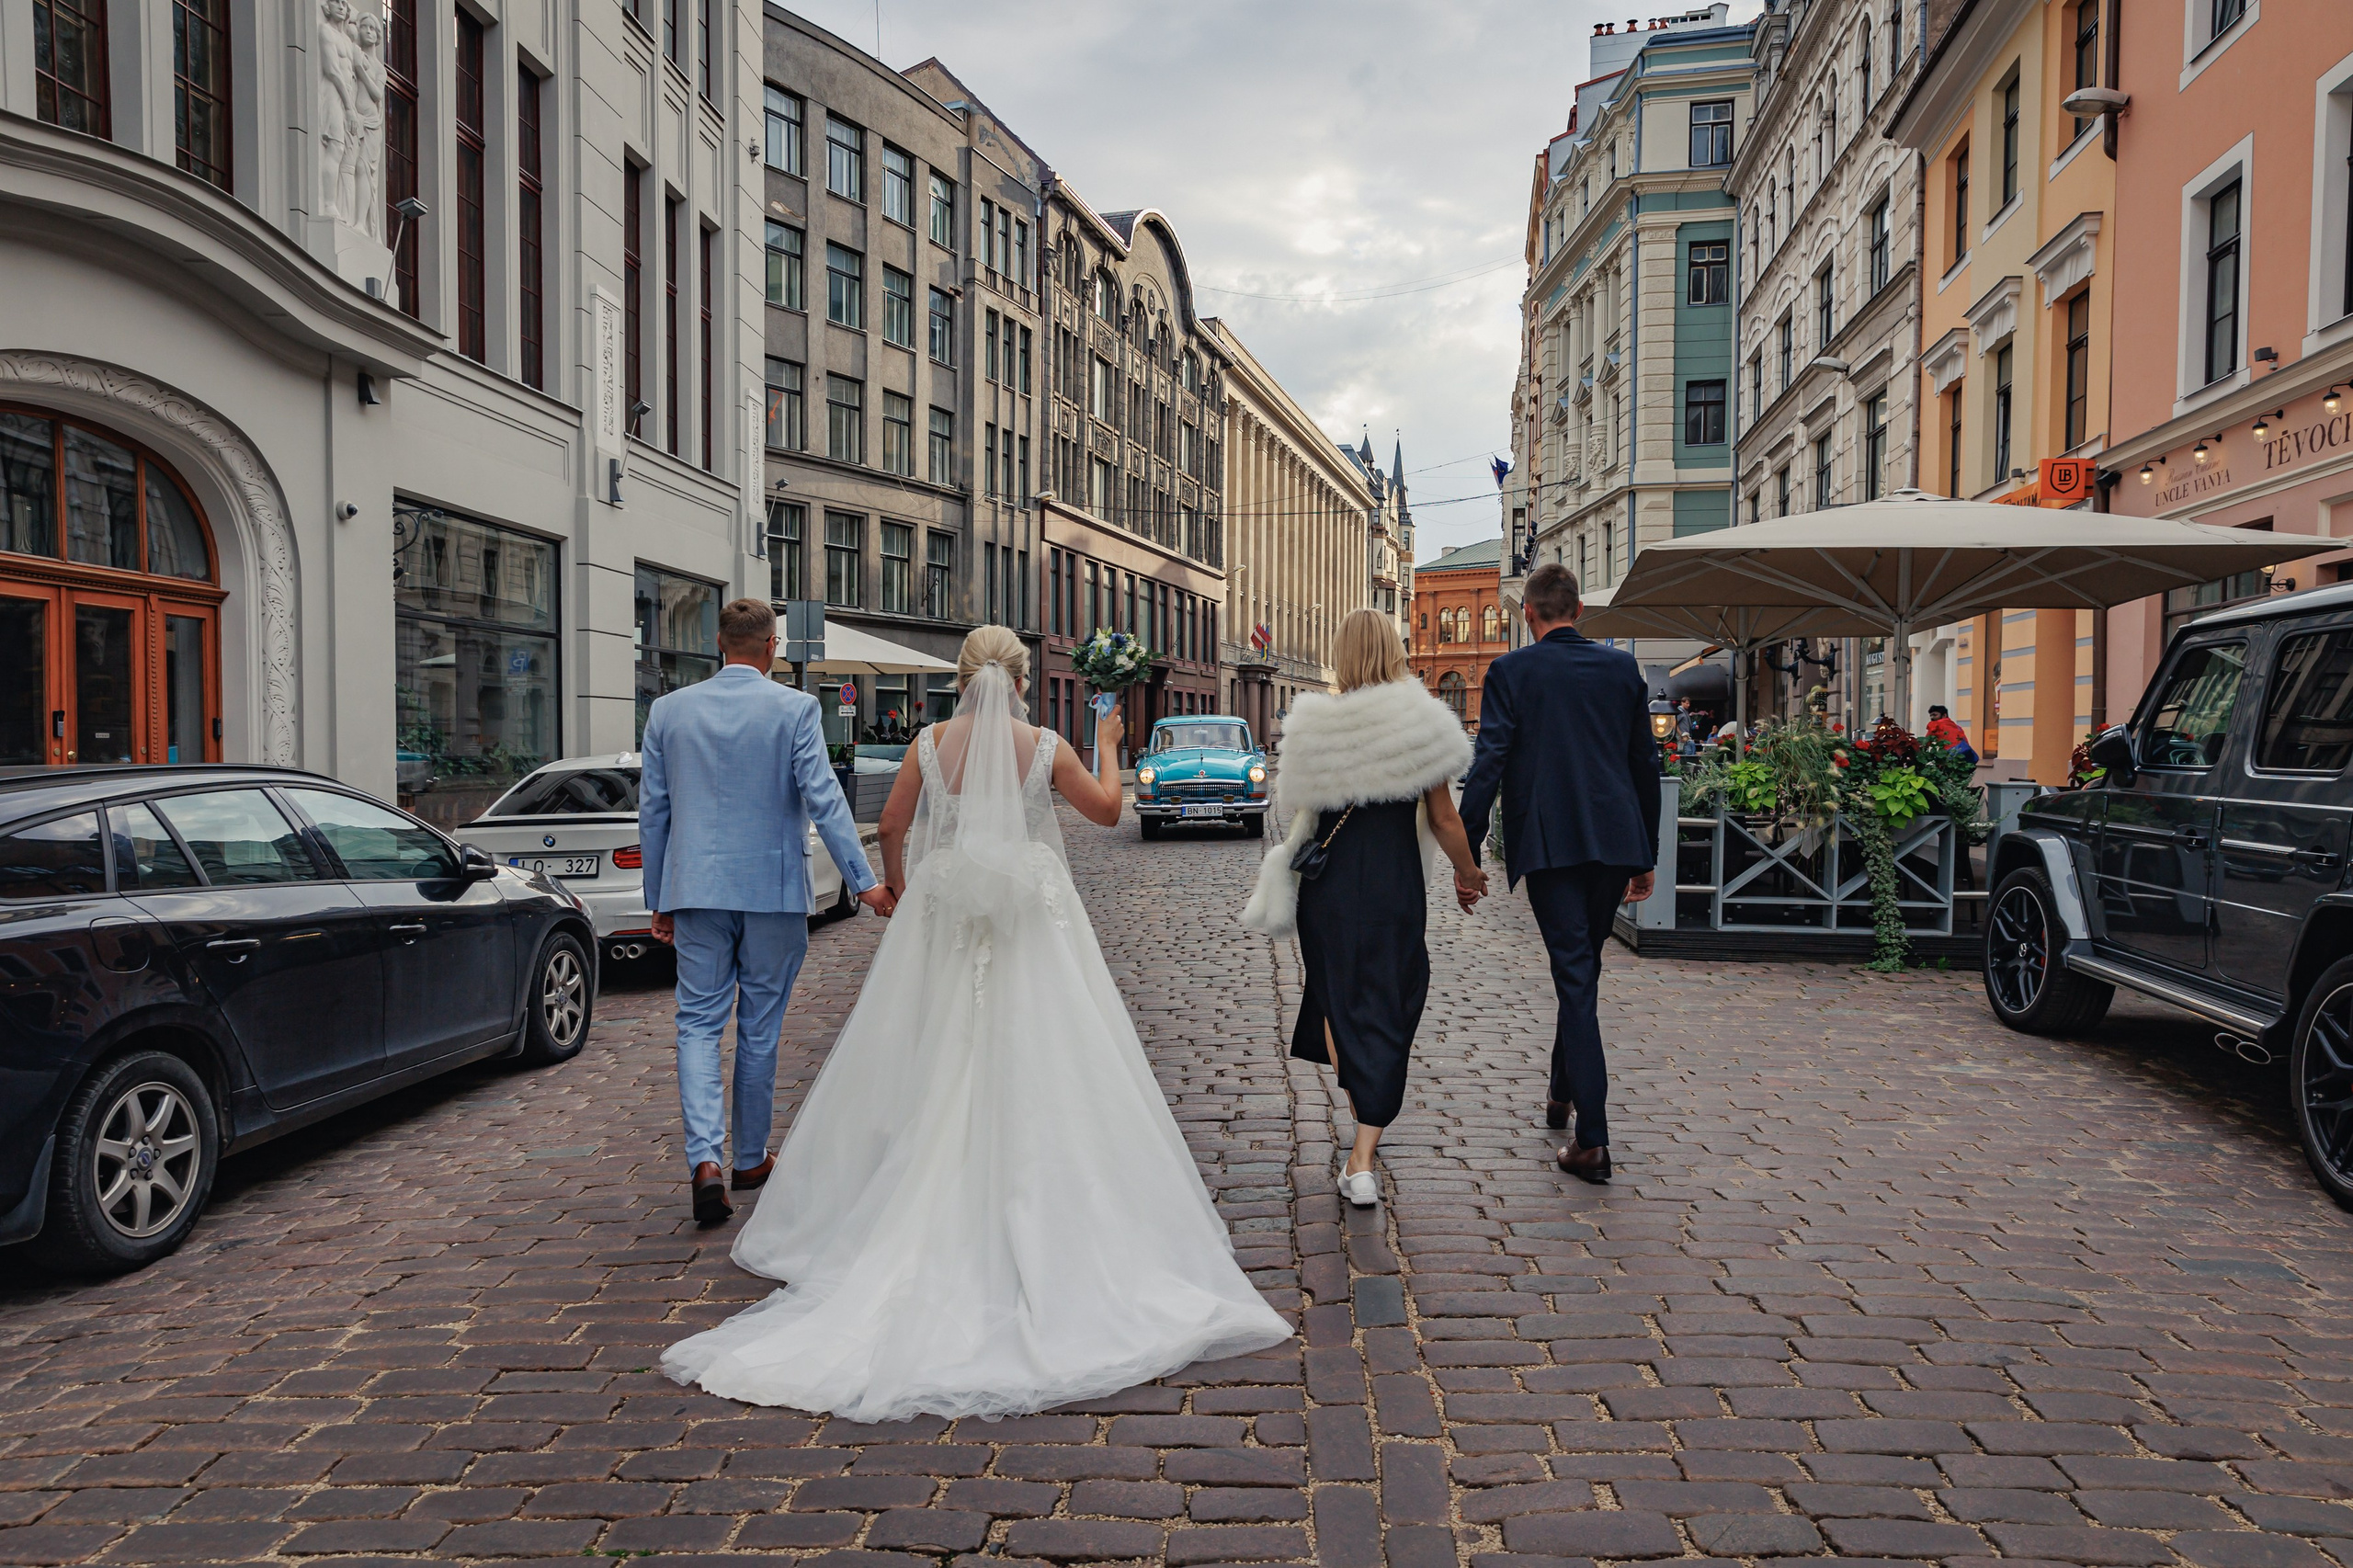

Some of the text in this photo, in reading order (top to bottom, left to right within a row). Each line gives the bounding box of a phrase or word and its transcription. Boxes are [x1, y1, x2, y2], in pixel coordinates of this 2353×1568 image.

[2263, 411, 2353, 470] TĒVOCI
[2059, 469, 2072, 482] LB
[2155, 469, 2231, 506] UNCLE VANYA
